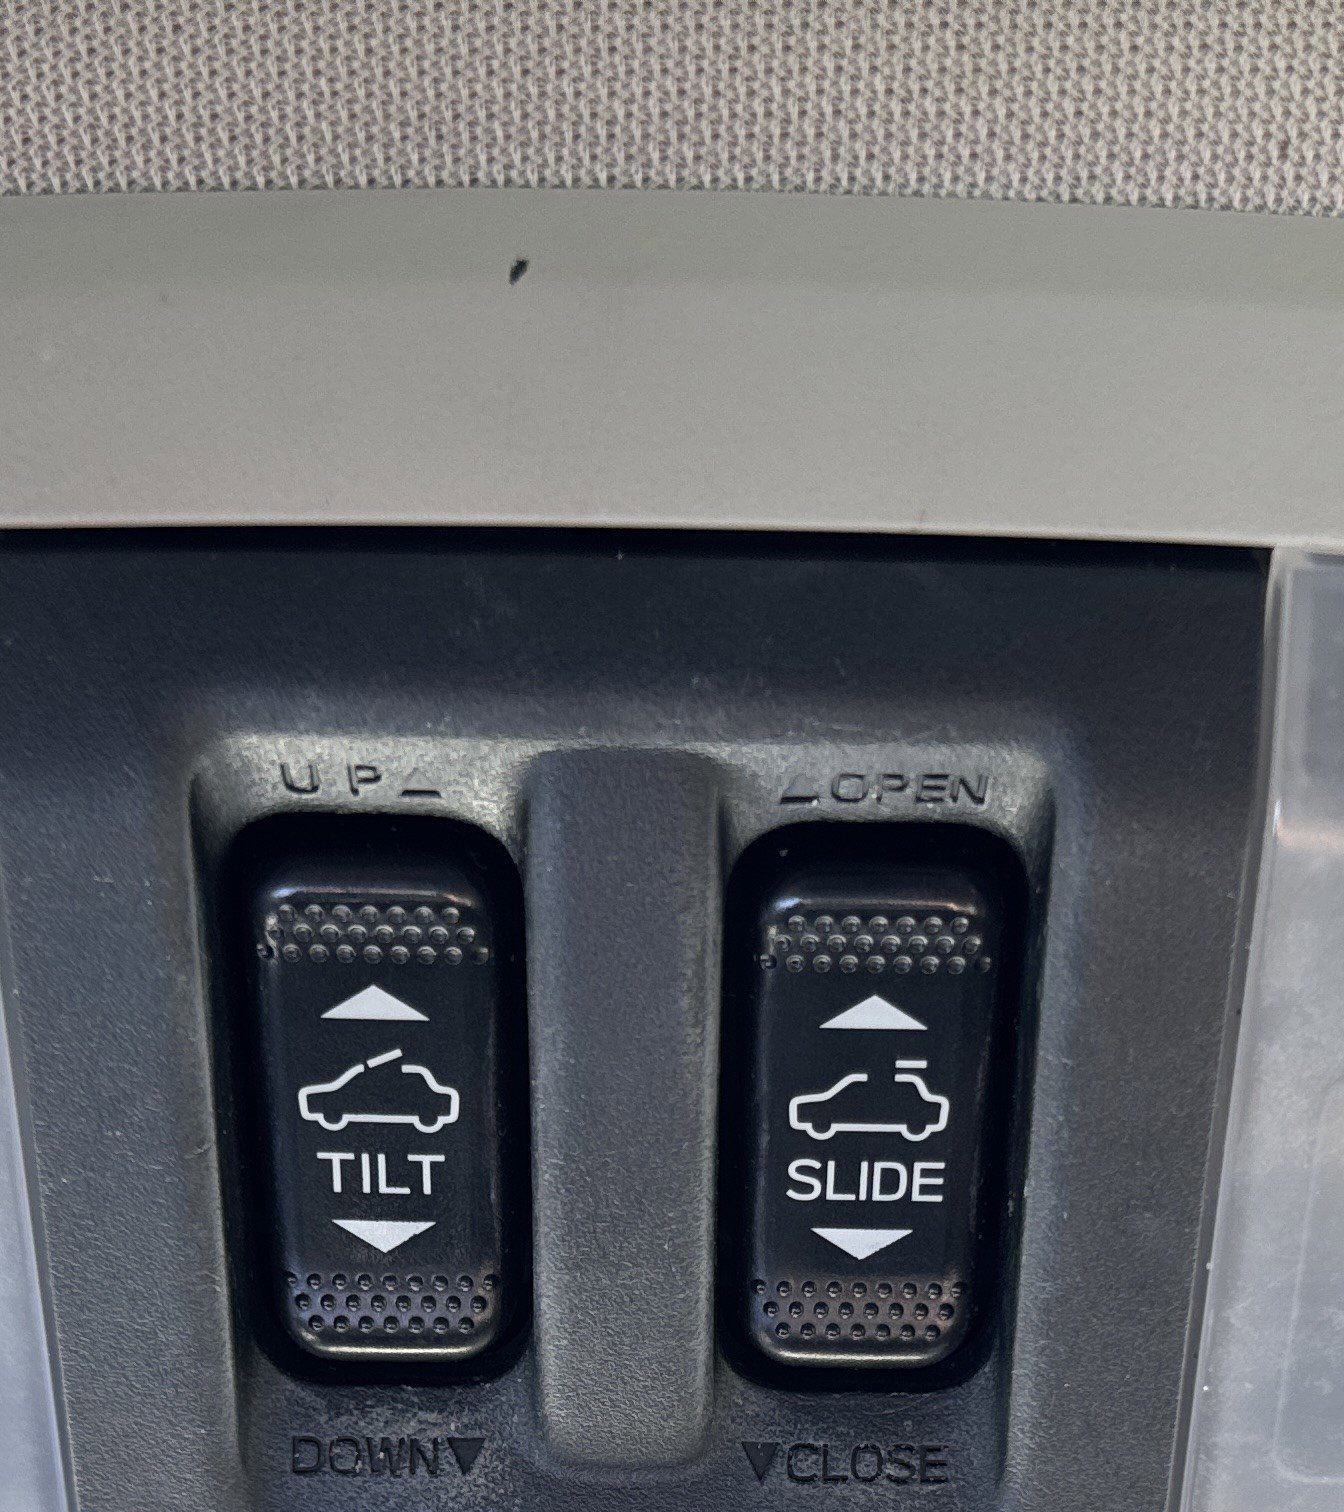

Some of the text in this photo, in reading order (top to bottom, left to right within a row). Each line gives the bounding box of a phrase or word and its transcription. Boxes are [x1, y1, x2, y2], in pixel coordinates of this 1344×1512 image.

[831, 774, 990, 803] OPEN
[316, 1151, 447, 1197] TILT
[785, 1158, 947, 1204] SLIDE
[290, 1436, 440, 1476] DOWN
[787, 1442, 950, 1484] CLOSE
